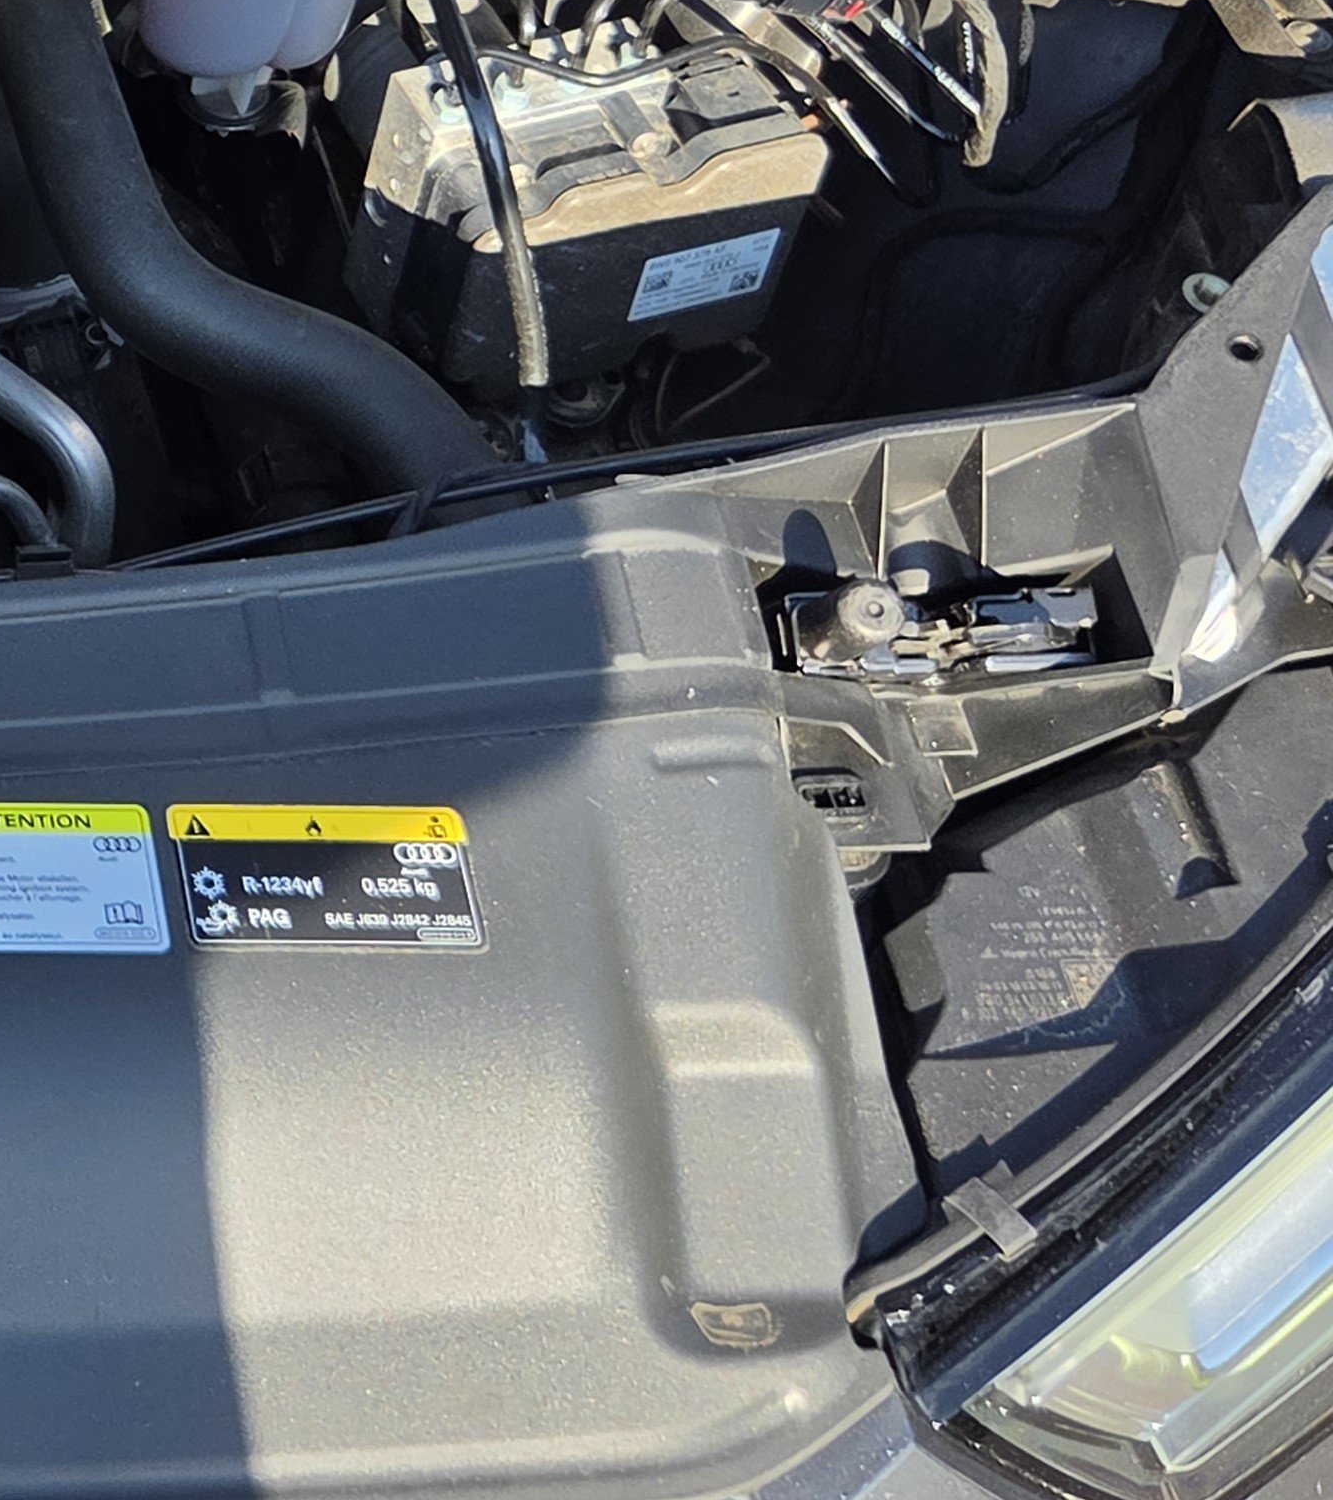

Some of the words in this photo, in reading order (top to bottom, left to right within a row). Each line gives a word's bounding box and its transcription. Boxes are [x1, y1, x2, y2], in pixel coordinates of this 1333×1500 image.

[241, 876, 325, 897] R-1234yf
[414, 878, 440, 900] kg
[248, 908, 292, 928] PAG
[325, 912, 355, 926] SAE
